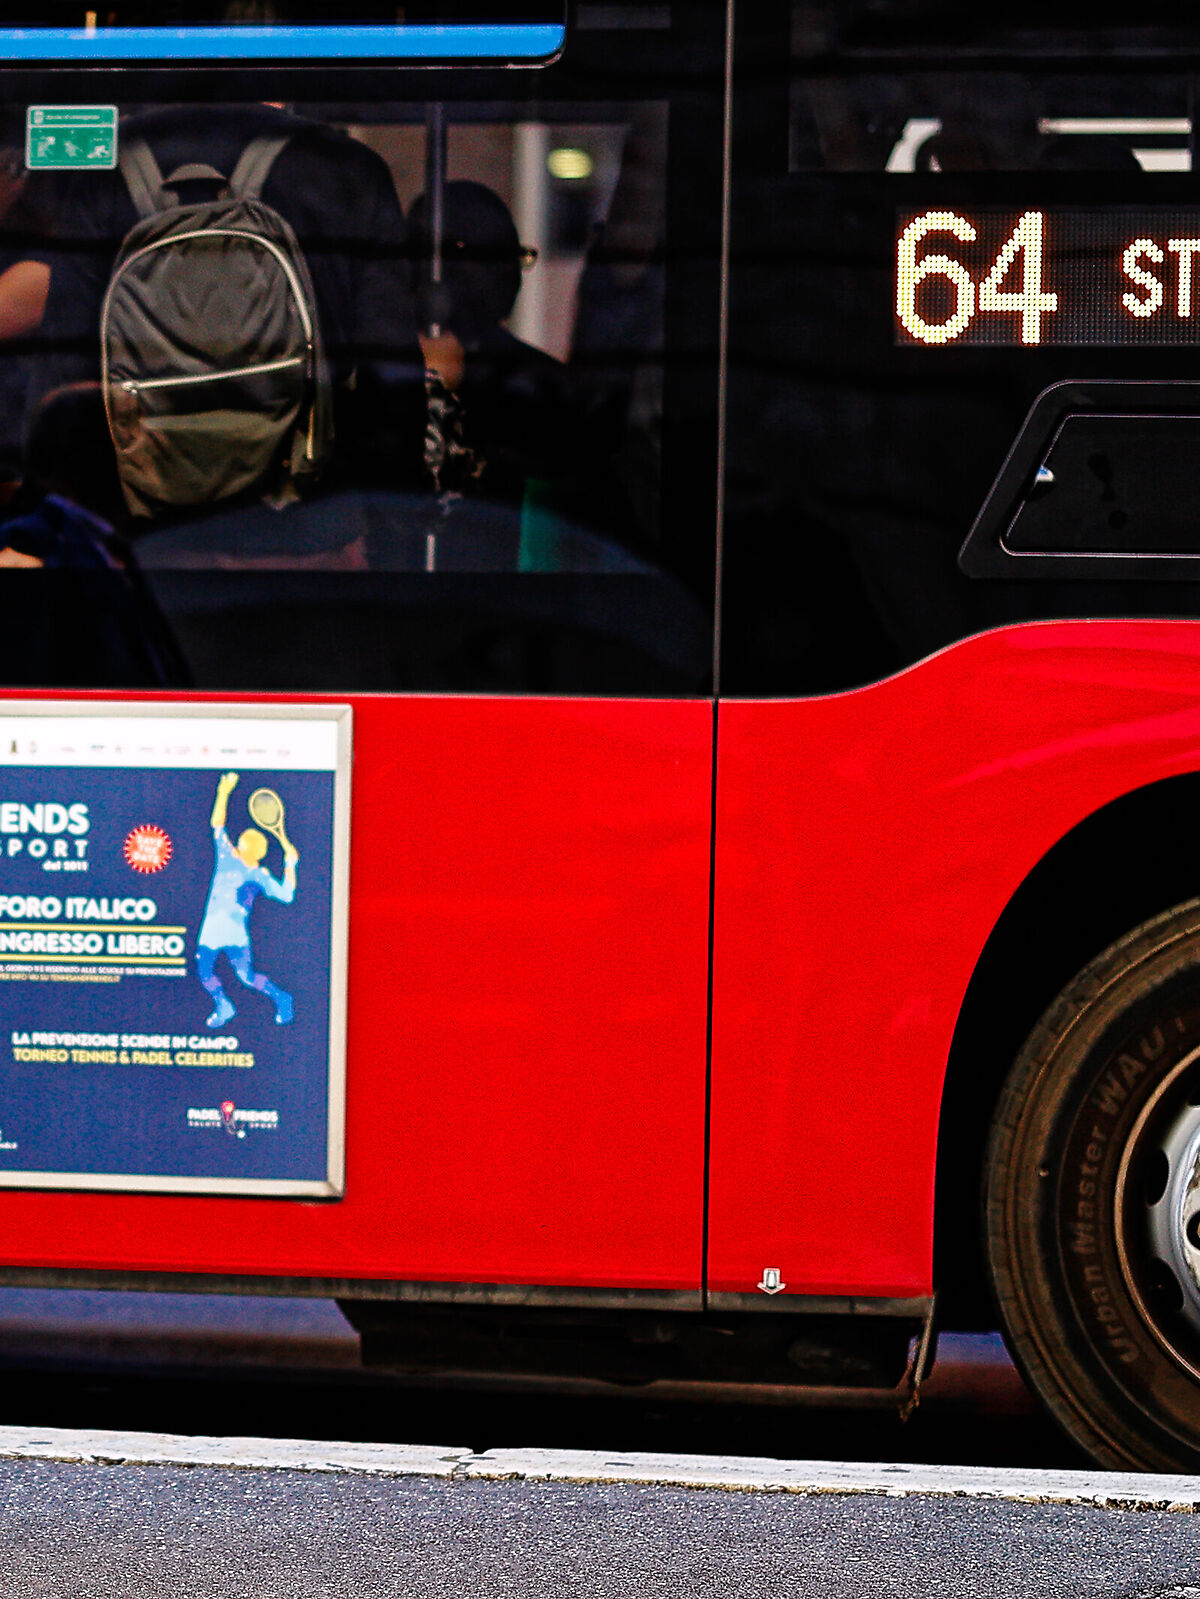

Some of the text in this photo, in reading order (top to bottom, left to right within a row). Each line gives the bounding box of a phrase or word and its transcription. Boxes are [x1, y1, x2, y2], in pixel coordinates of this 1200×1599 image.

[897, 211, 1058, 344] 64
[65, 896, 158, 921] ITALICO
[106, 934, 185, 956] LIBERO
[12, 1031, 239, 1050] LA PREVENZIONE SCENDE IN CAMPO
[13, 1048, 255, 1067] TORNEO TENNIS & PADEL CELEBRITIES
[187, 1108, 279, 1123] PADEL FRIENDS
[1071, 1124, 1108, 1255] Master
[1084, 1265, 1140, 1364] Urban
